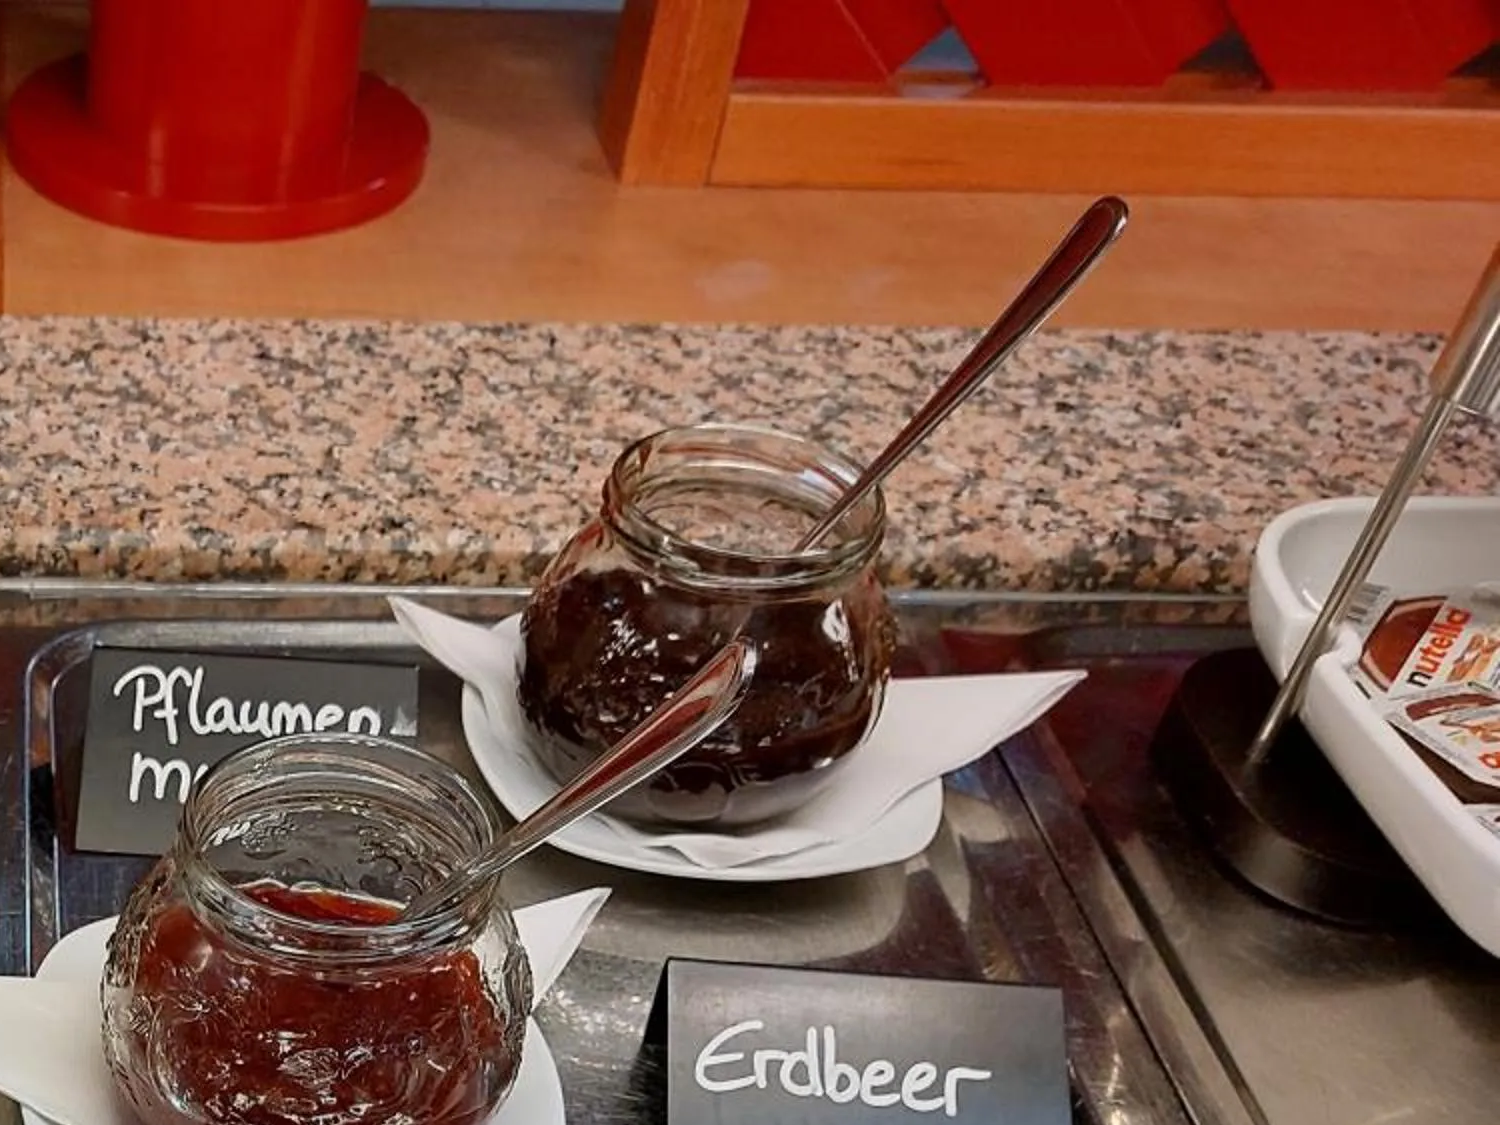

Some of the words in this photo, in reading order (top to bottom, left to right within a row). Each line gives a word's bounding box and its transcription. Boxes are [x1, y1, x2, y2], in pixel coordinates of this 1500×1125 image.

[1407, 608, 1472, 689] nutella
[113, 665, 382, 745] Pflaumen
[695, 1020, 992, 1117] Erdbeer
